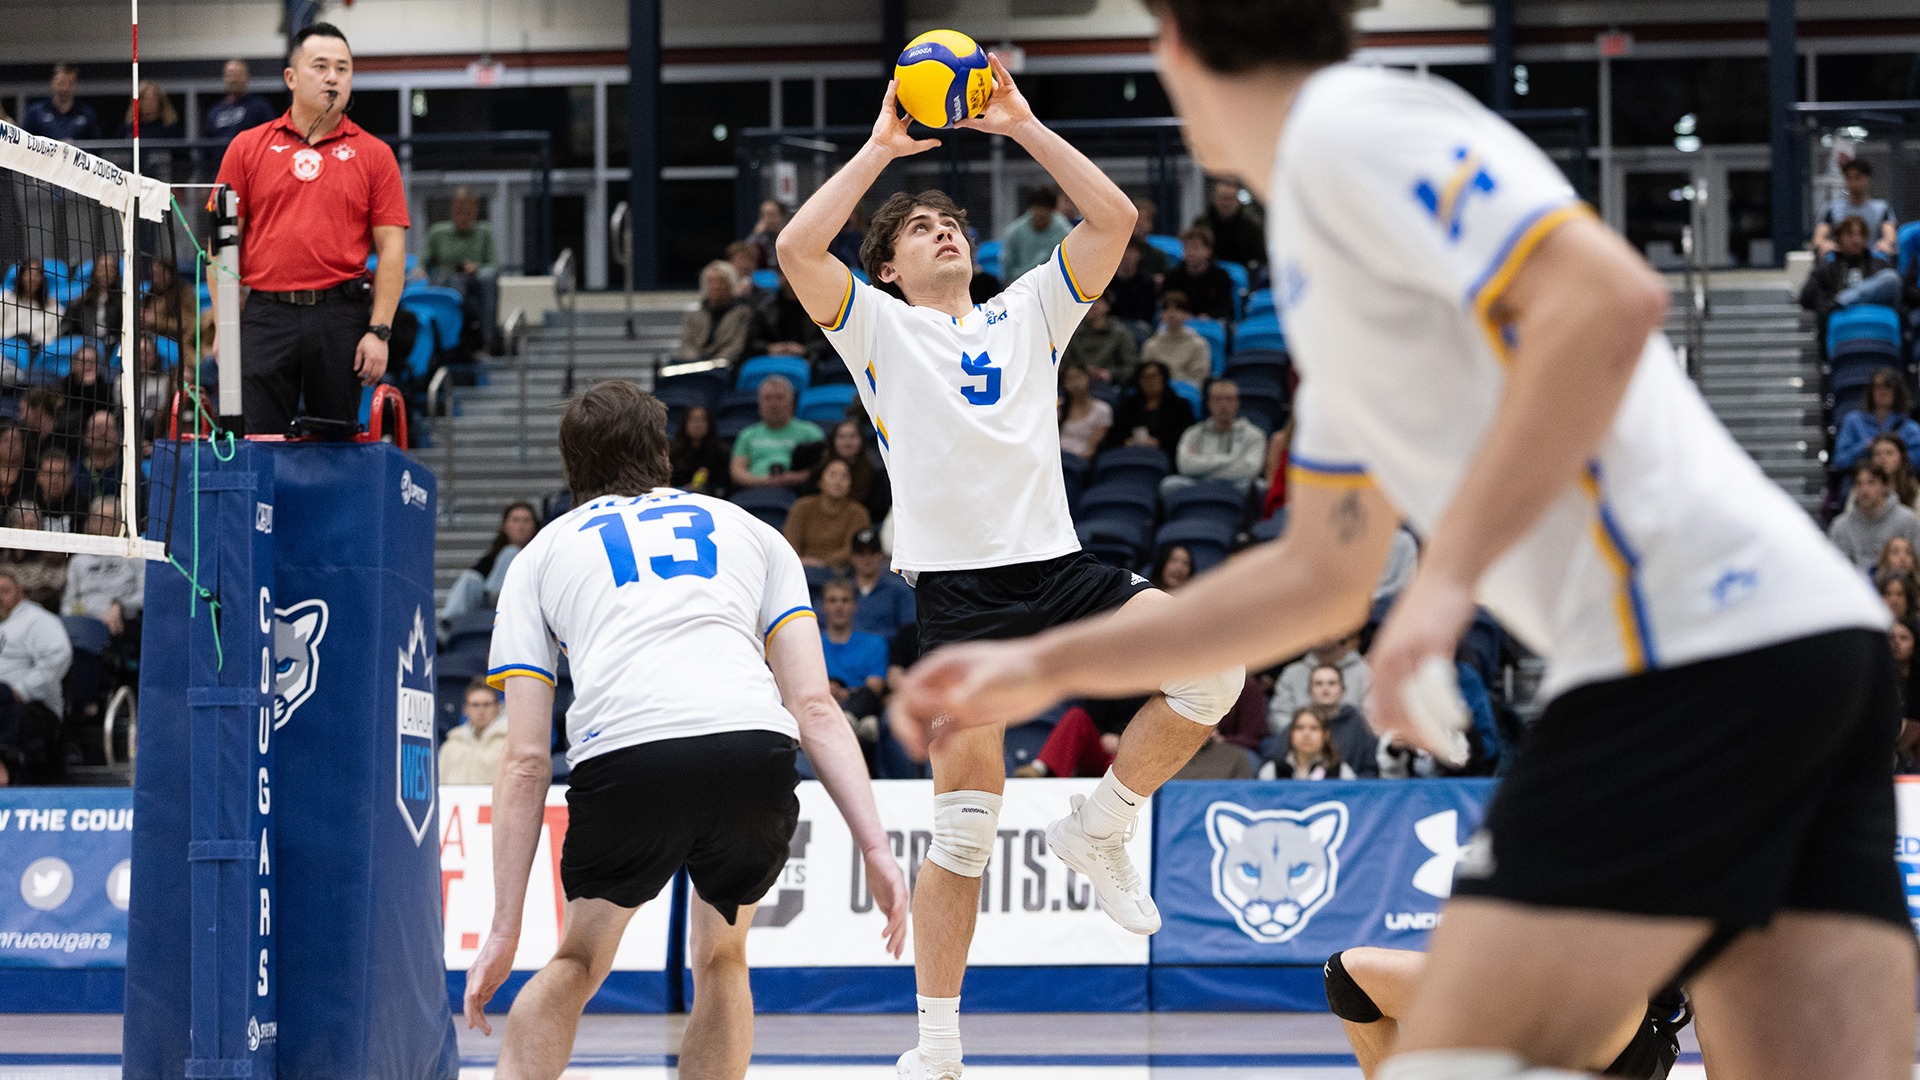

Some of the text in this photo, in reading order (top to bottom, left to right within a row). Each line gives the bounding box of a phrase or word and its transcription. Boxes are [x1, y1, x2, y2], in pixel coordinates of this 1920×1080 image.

[960, 351, 1002, 406] 5
[578, 504, 718, 588] 13
[257, 585, 272, 998] COUGARS
[401, 743, 432, 801] WEST
[15, 808, 68, 832] THE
